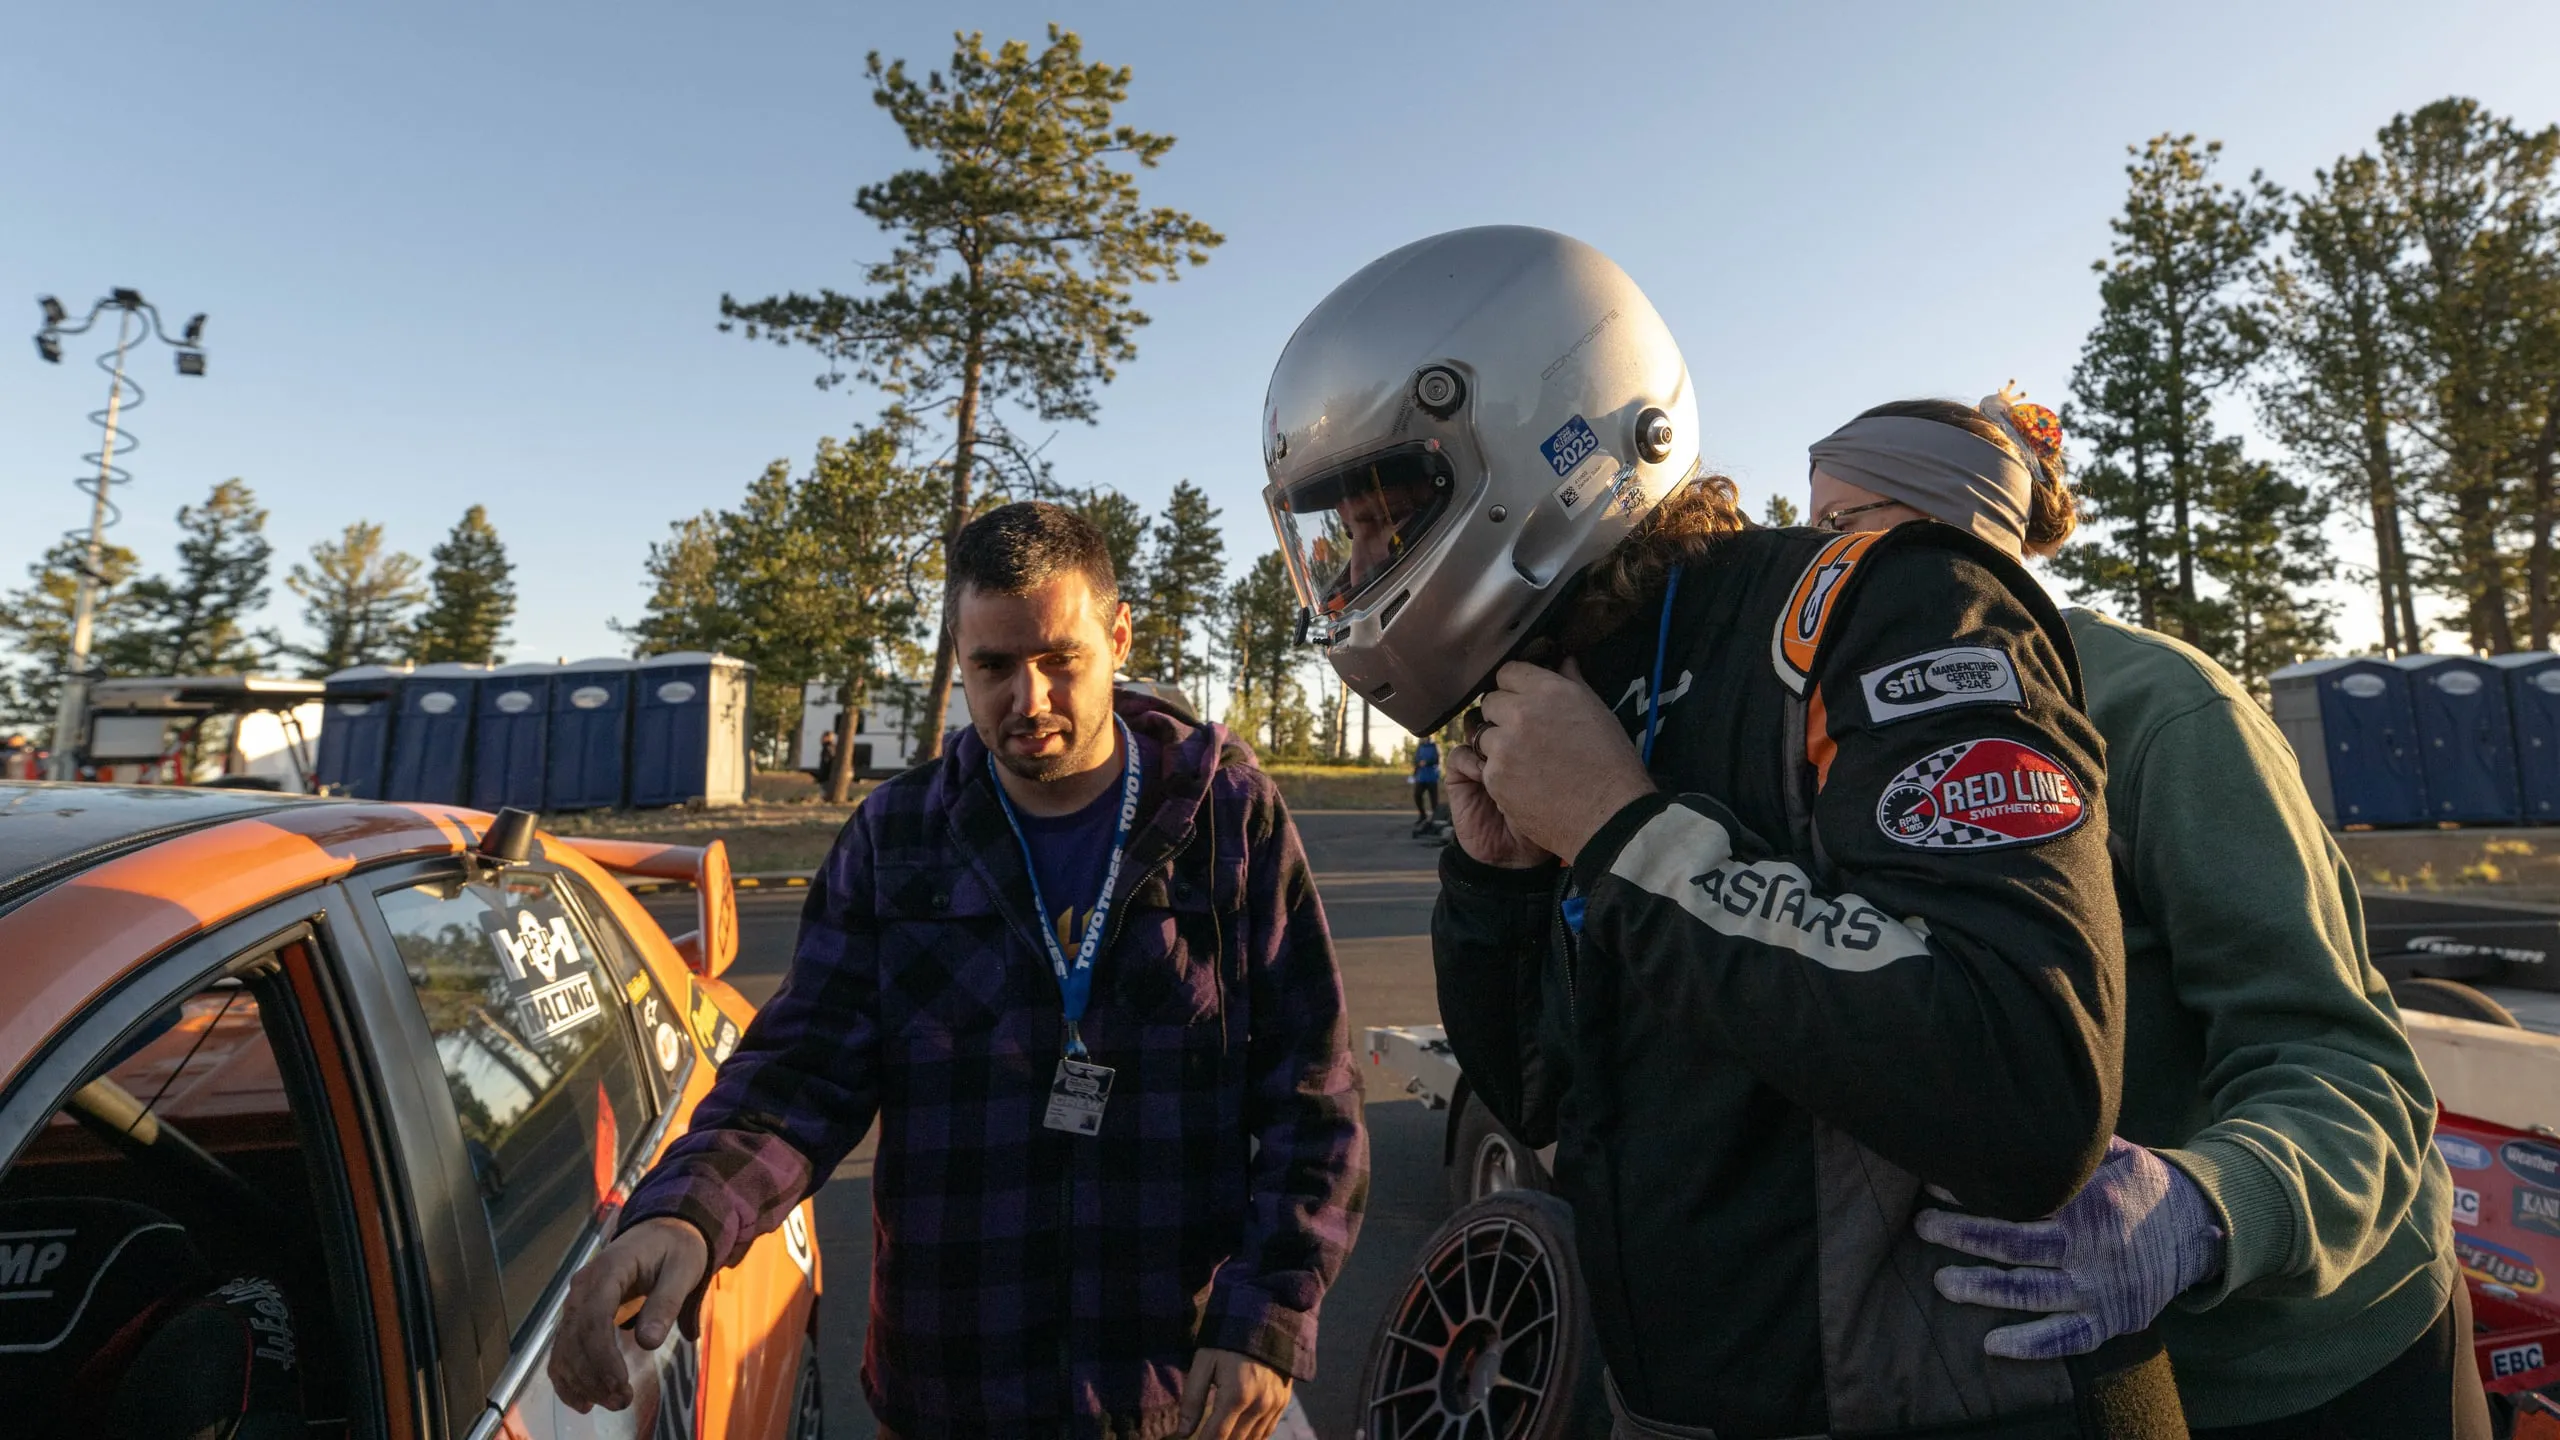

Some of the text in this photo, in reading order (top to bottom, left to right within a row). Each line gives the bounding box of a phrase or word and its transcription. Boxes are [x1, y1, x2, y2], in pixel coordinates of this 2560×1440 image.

[1540, 309, 1619, 381] COMPOSITE
[1553, 429, 1596, 474] 2025
[1885, 667, 1926, 699] sfi
[1932, 661, 1999, 676] MANUFACTURER
[1947, 671, 1991, 682] CERTIFIED
[1956, 679, 1991, 690] 3-2A/5
[1119, 776, 1140, 832] TOYO
[1942, 772, 2007, 814] RED
[1969, 803, 2063, 821] SYNTHETIC OIL
[1899, 814, 1920, 828] RPM
[1689, 868, 1888, 951] ASTARS
[1076, 909, 1106, 970] TOYO
[521, 981, 595, 1034] RACING
[0, 1242, 68, 1285] MP
[2494, 1347, 2542, 1377] EBC
